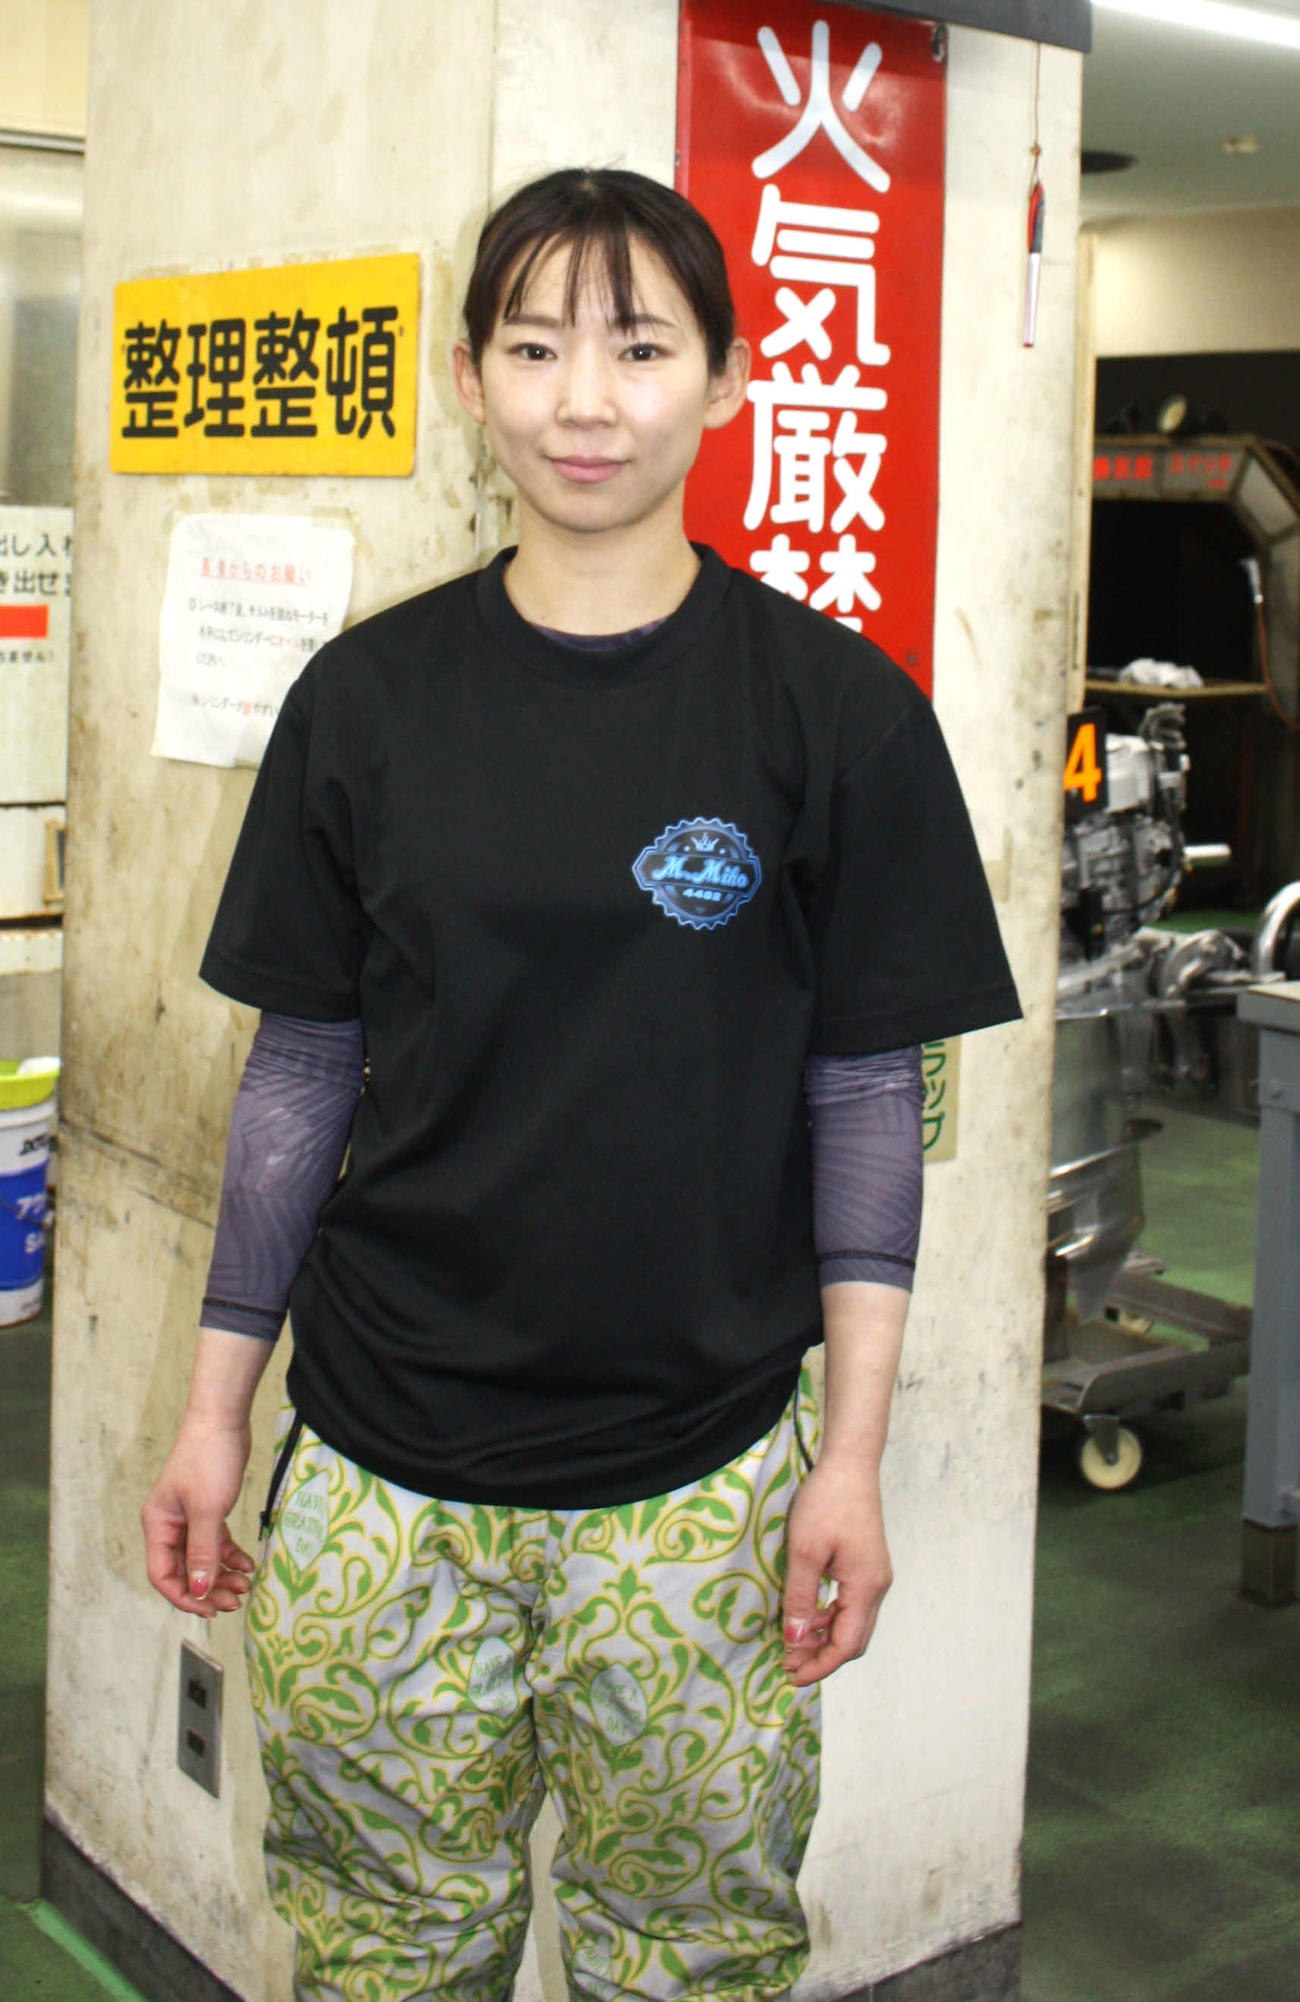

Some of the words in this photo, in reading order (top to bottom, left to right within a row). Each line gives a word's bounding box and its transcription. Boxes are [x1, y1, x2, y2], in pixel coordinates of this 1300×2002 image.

[121, 305, 399, 439] 整理整頓
[1063, 722, 1102, 803] 4
